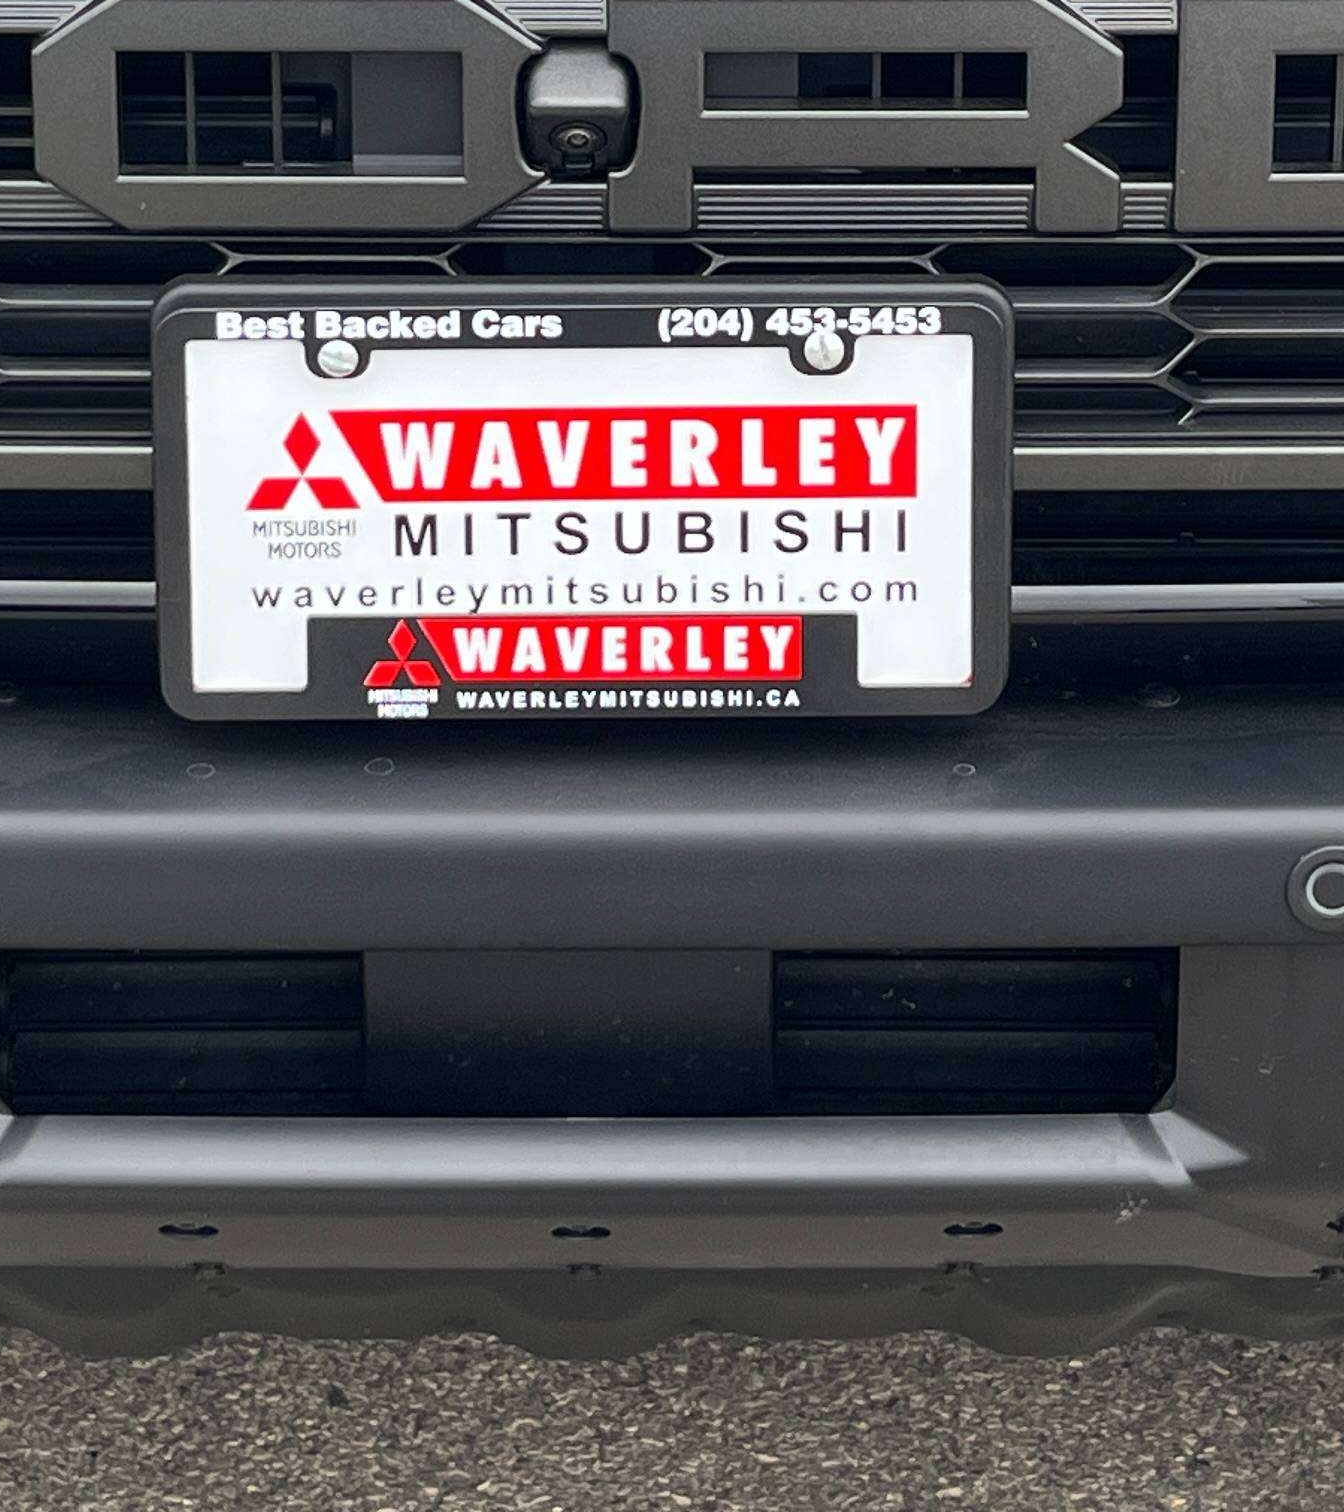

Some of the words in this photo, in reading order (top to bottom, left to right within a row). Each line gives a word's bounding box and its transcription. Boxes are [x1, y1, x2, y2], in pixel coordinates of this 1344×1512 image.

[215, 310, 305, 339] Best
[315, 309, 461, 338] Backed
[471, 308, 564, 339] Cars
[657, 307, 754, 343] (204)
[765, 306, 942, 335] 453-5453
[379, 416, 907, 491] WAVERLEY
[253, 519, 357, 537] MITSUBISHI
[394, 510, 907, 557] MITSUBISHI
[268, 541, 342, 559] MOTORS
[252, 575, 919, 614] waverleymitsubishi.com
[452, 624, 795, 673] WAVERLEY
[367, 688, 439, 704] MITSUBISHI
[456, 688, 800, 709] WAVERLEYMITSUBISHI.CA
[377, 703, 430, 719] MOTORS
